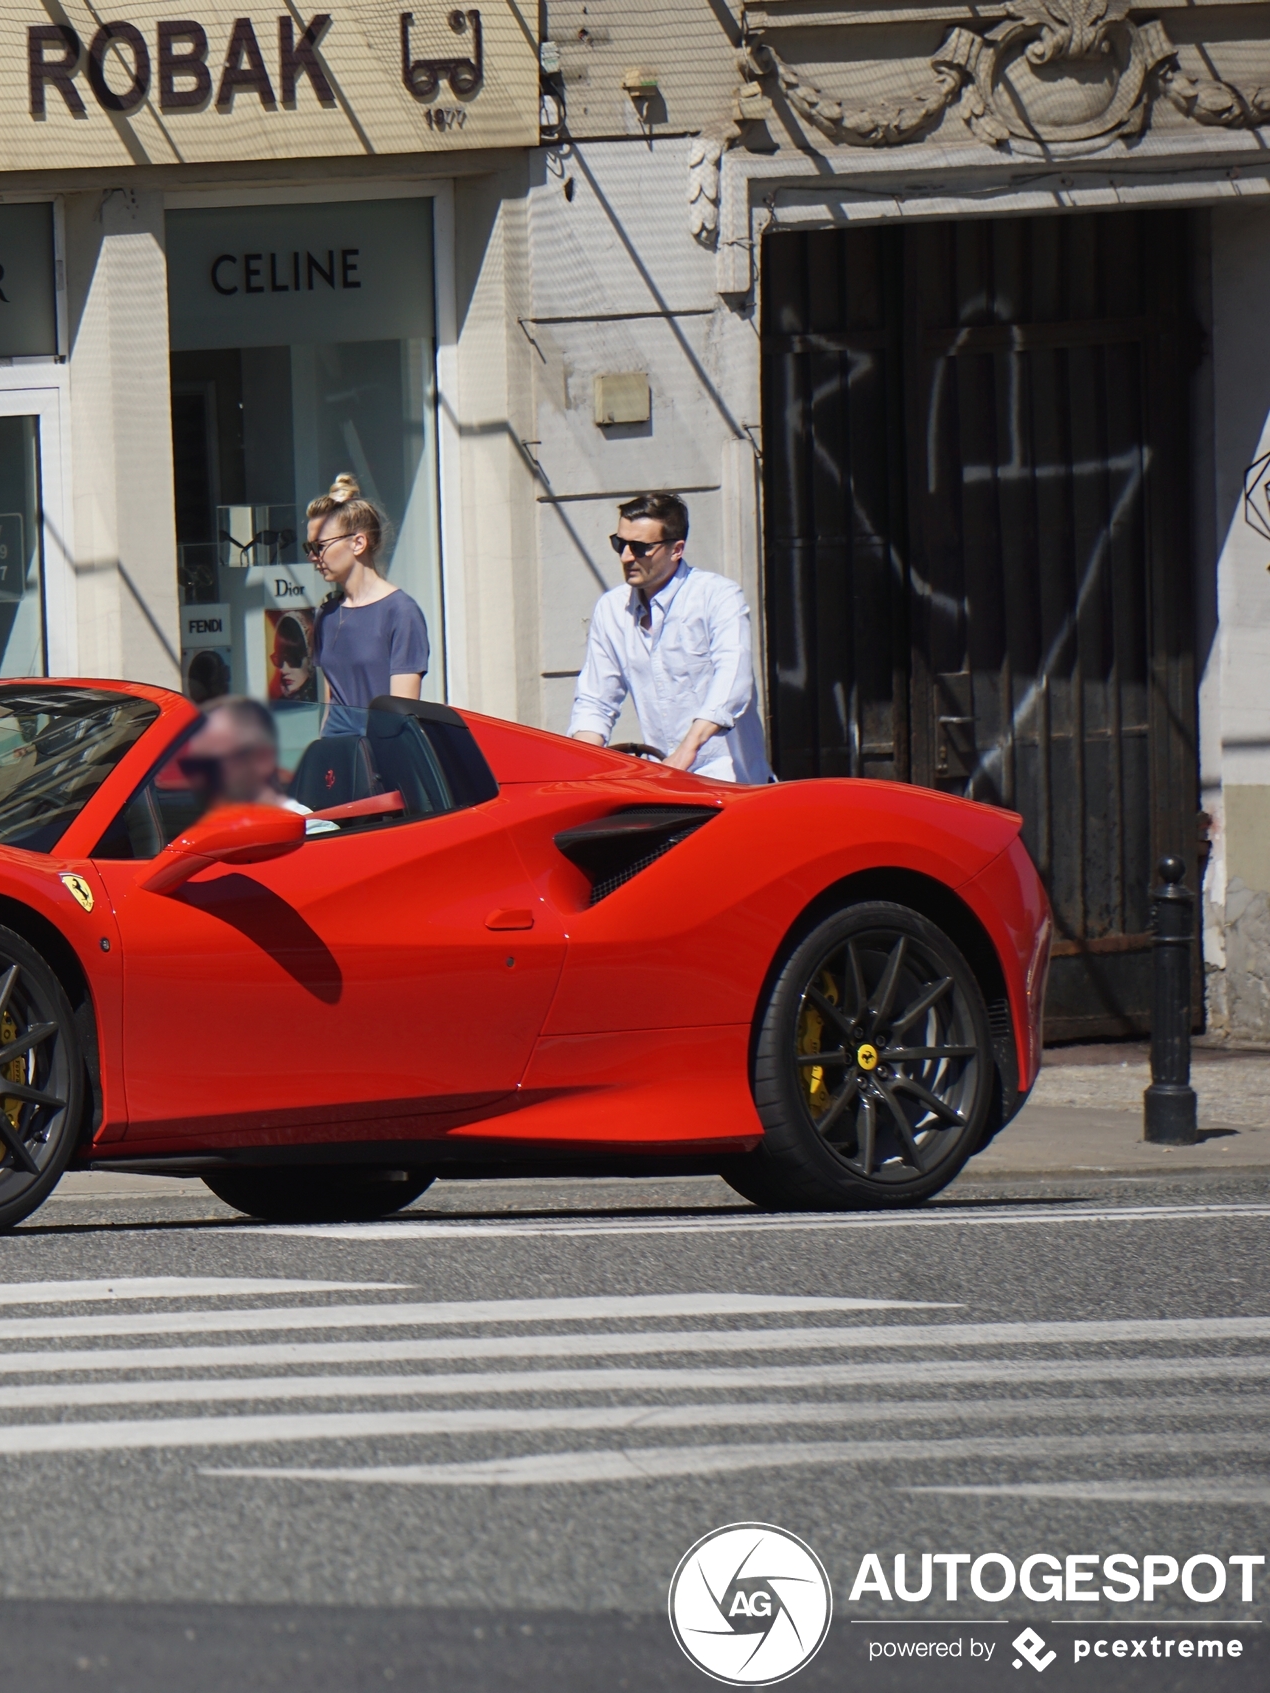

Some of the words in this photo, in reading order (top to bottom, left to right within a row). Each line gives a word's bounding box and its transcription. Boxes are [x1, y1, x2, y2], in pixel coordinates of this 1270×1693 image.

[28, 14, 336, 114] ROBAK
[424, 107, 466, 130] 1977
[211, 248, 362, 296] CELINE
[275, 579, 305, 597] Dior
[189, 619, 222, 634] FENDI
